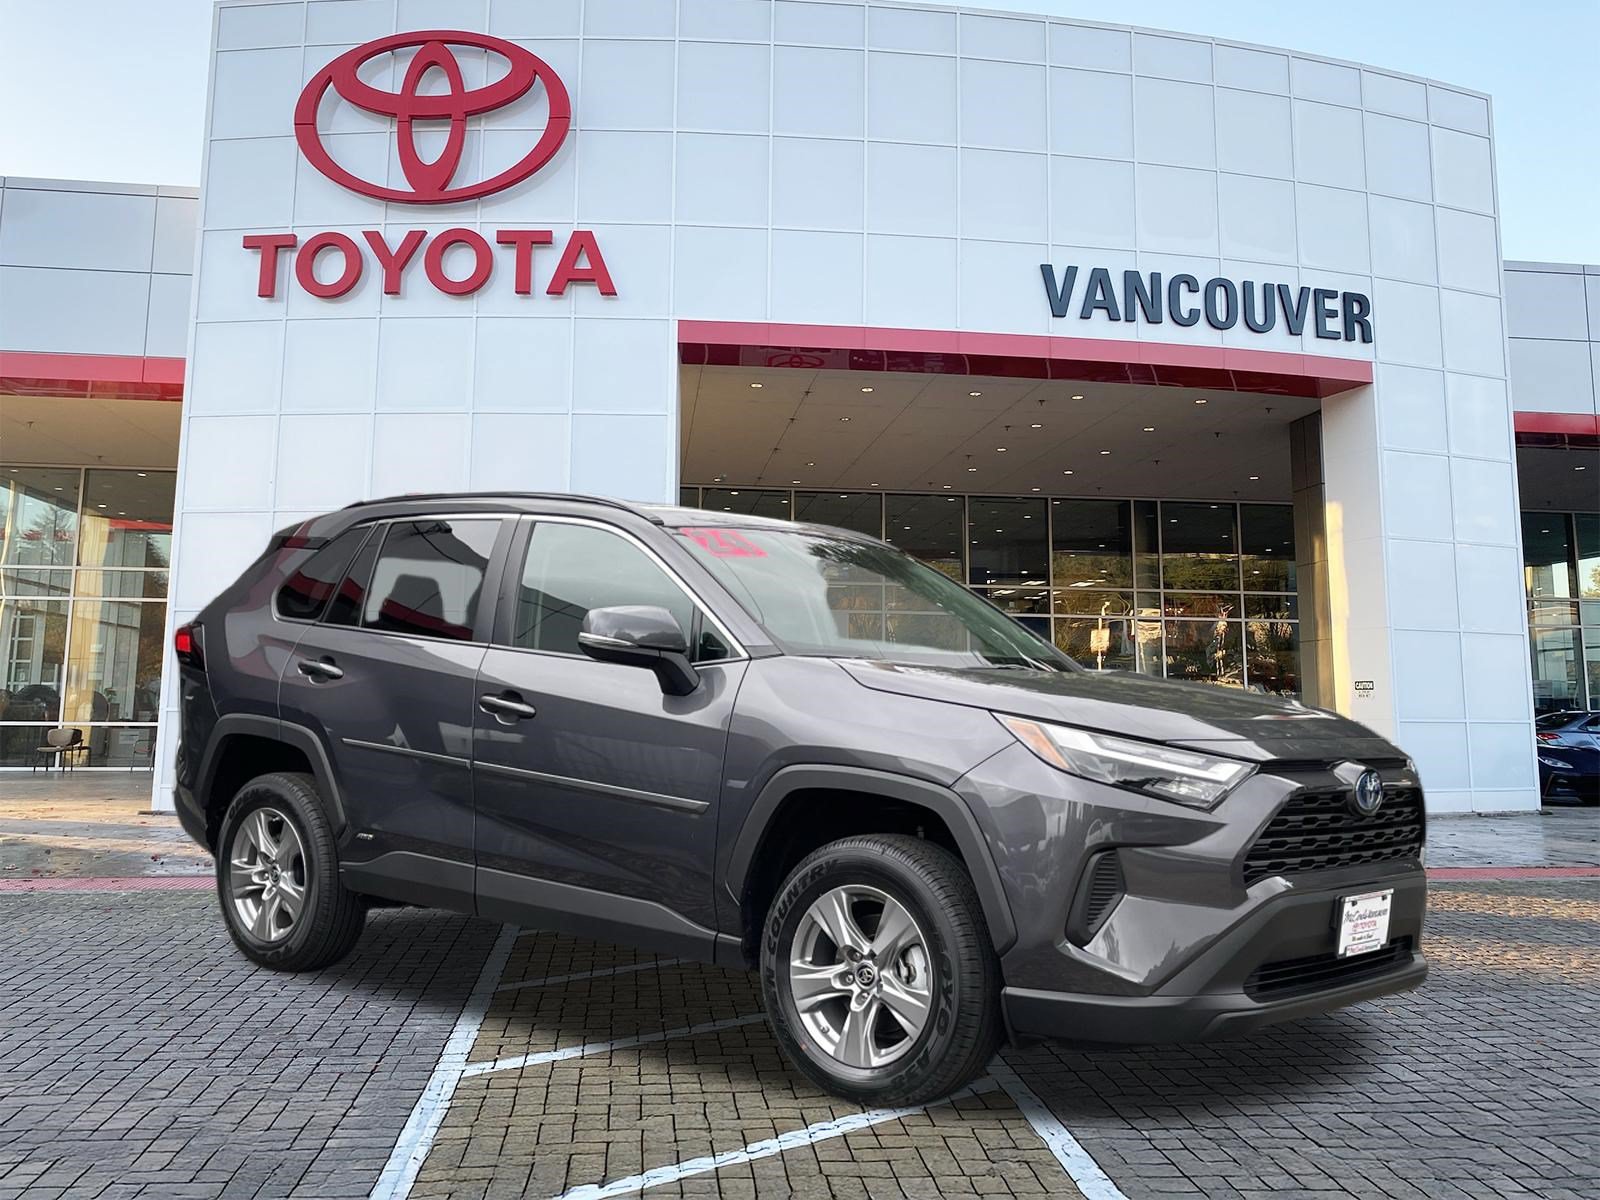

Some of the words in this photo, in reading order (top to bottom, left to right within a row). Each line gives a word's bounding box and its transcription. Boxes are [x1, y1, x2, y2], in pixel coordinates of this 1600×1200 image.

[243, 228, 618, 298] TOYOTA
[1040, 264, 1373, 344] VANCOUVER
[767, 859, 839, 955] COUNTRY
